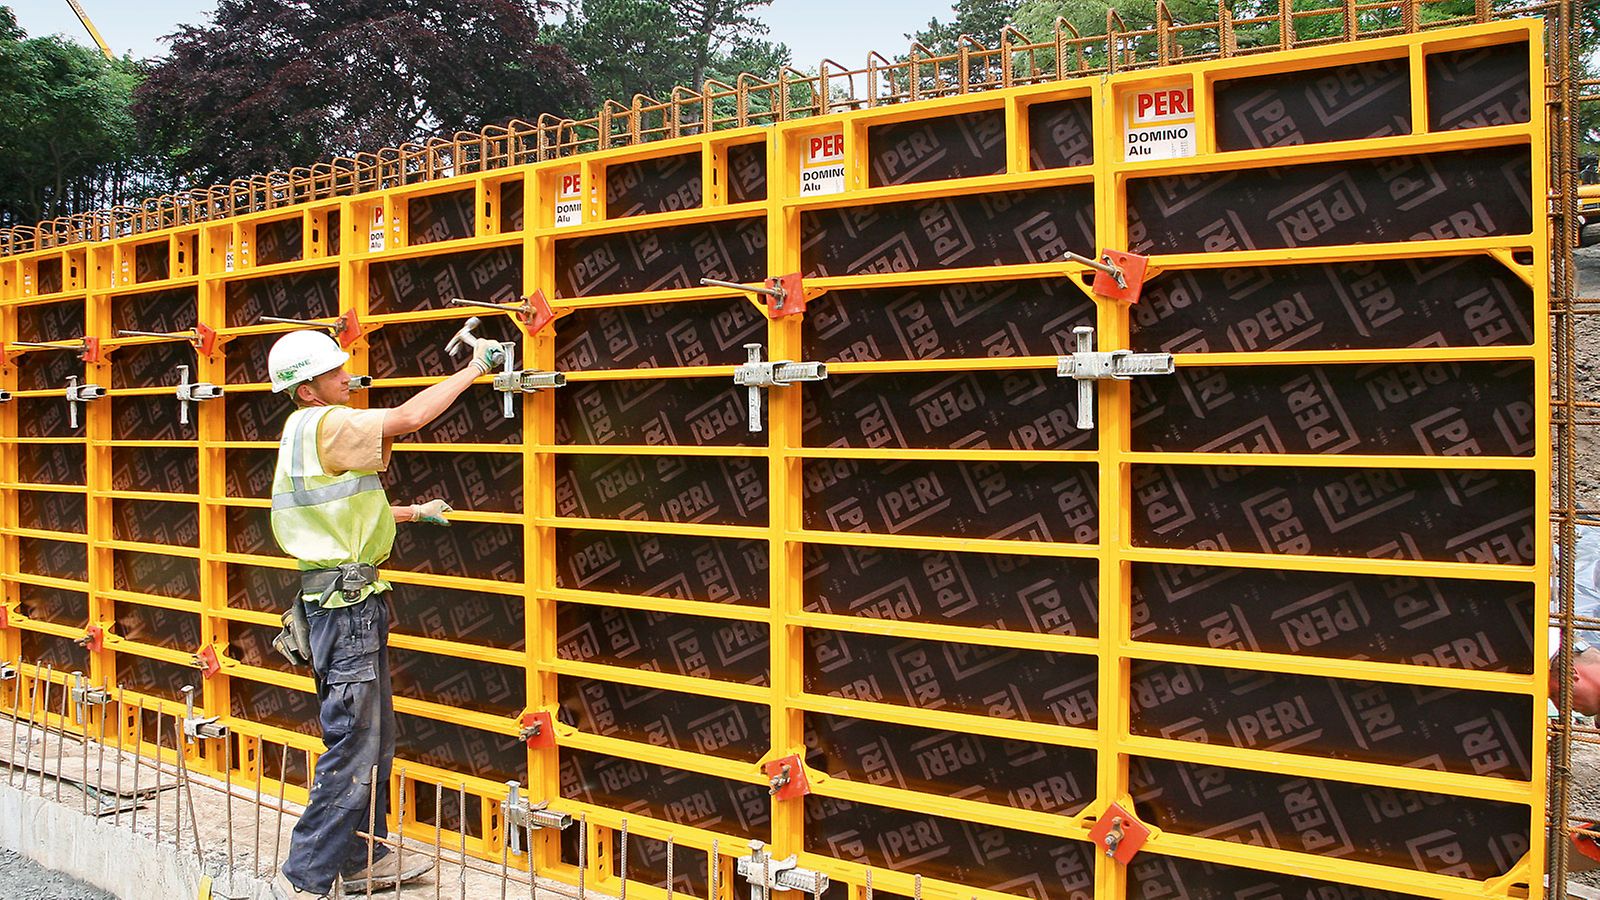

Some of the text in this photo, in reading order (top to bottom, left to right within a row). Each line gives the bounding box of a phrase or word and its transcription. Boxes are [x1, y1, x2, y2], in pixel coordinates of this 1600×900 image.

[1138, 88, 1194, 117] PERI
[810, 134, 844, 159] PER
[881, 125, 941, 177] PERI
[1128, 128, 1188, 143] DOMINO
[1129, 145, 1152, 156] Alu
[803, 183, 821, 192] Alu
[557, 215, 571, 223] Alu
[1276, 189, 1356, 249] PERI
[470, 247, 508, 290] PERI
[573, 241, 617, 287] PERI
[235, 293, 261, 327] PERI
[898, 300, 946, 360] PERI
[1238, 291, 1315, 351] PERI
[582, 389, 617, 445] PERI
[689, 400, 739, 446] PERI
[915, 382, 977, 434] PERI
[1280, 373, 1341, 450] PERI
[461, 459, 490, 507] PERI
[595, 461, 639, 504] PERI
[666, 480, 716, 522] PERI
[885, 471, 945, 520] PERI
[573, 536, 617, 576] PERI
[690, 543, 730, 601] PERI
[1279, 597, 1360, 653] PERI
[902, 648, 947, 709] PERI
[585, 683, 620, 737] PERI
[1237, 694, 1315, 747] PERI
[691, 716, 742, 755] PERI
[915, 736, 977, 780] PERI
[670, 789, 719, 825] PERI
[1016, 770, 1081, 812] PERI
[885, 817, 944, 858] PERI
[1277, 779, 1337, 851] PERI
